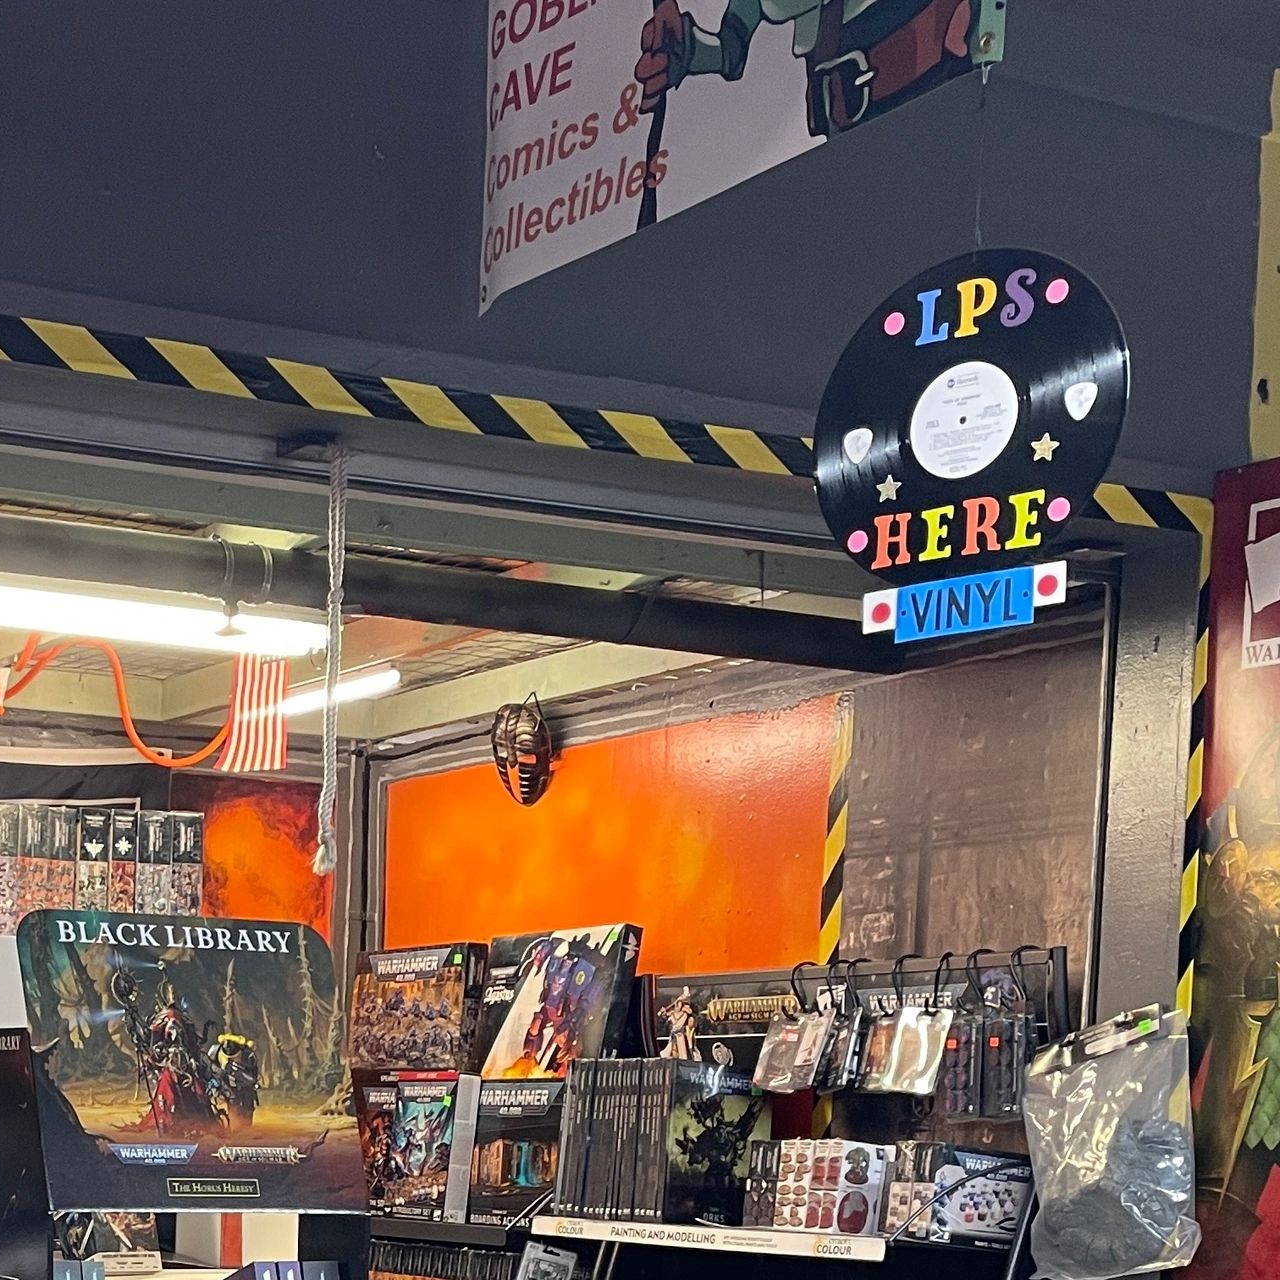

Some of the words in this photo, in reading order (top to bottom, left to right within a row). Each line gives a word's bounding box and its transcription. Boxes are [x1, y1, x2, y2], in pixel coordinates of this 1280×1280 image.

[491, 0, 597, 59] GOB
[489, 41, 576, 131] CAVE
[486, 112, 600, 204] Comics
[612, 82, 640, 134] &
[483, 149, 670, 274] Collectibles
[915, 267, 1037, 346] LPS
[871, 489, 1046, 570] HERE
[910, 577, 1018, 633] VINYL
[55, 919, 166, 949] BLACK
[177, 923, 292, 954] LIBRARY
[377, 956, 438, 975] WARHAMMER
[480, 1089, 549, 1106] WARHAMMER
[120, 1148, 188, 1159] WARHAMMER
[173, 1182, 191, 1192] THE
[223, 1183, 254, 1193] HERESY
[470, 1214, 501, 1226] BOARDING
[502, 1215, 530, 1227] ACTONS
[702, 1212, 725, 1223] ORKS
[610, 1227, 647, 1239] PAINTING
[647, 1230, 665, 1240] AND
[666, 1231, 716, 1244] MODELLING
[816, 1243, 852, 1256] COLOUR
